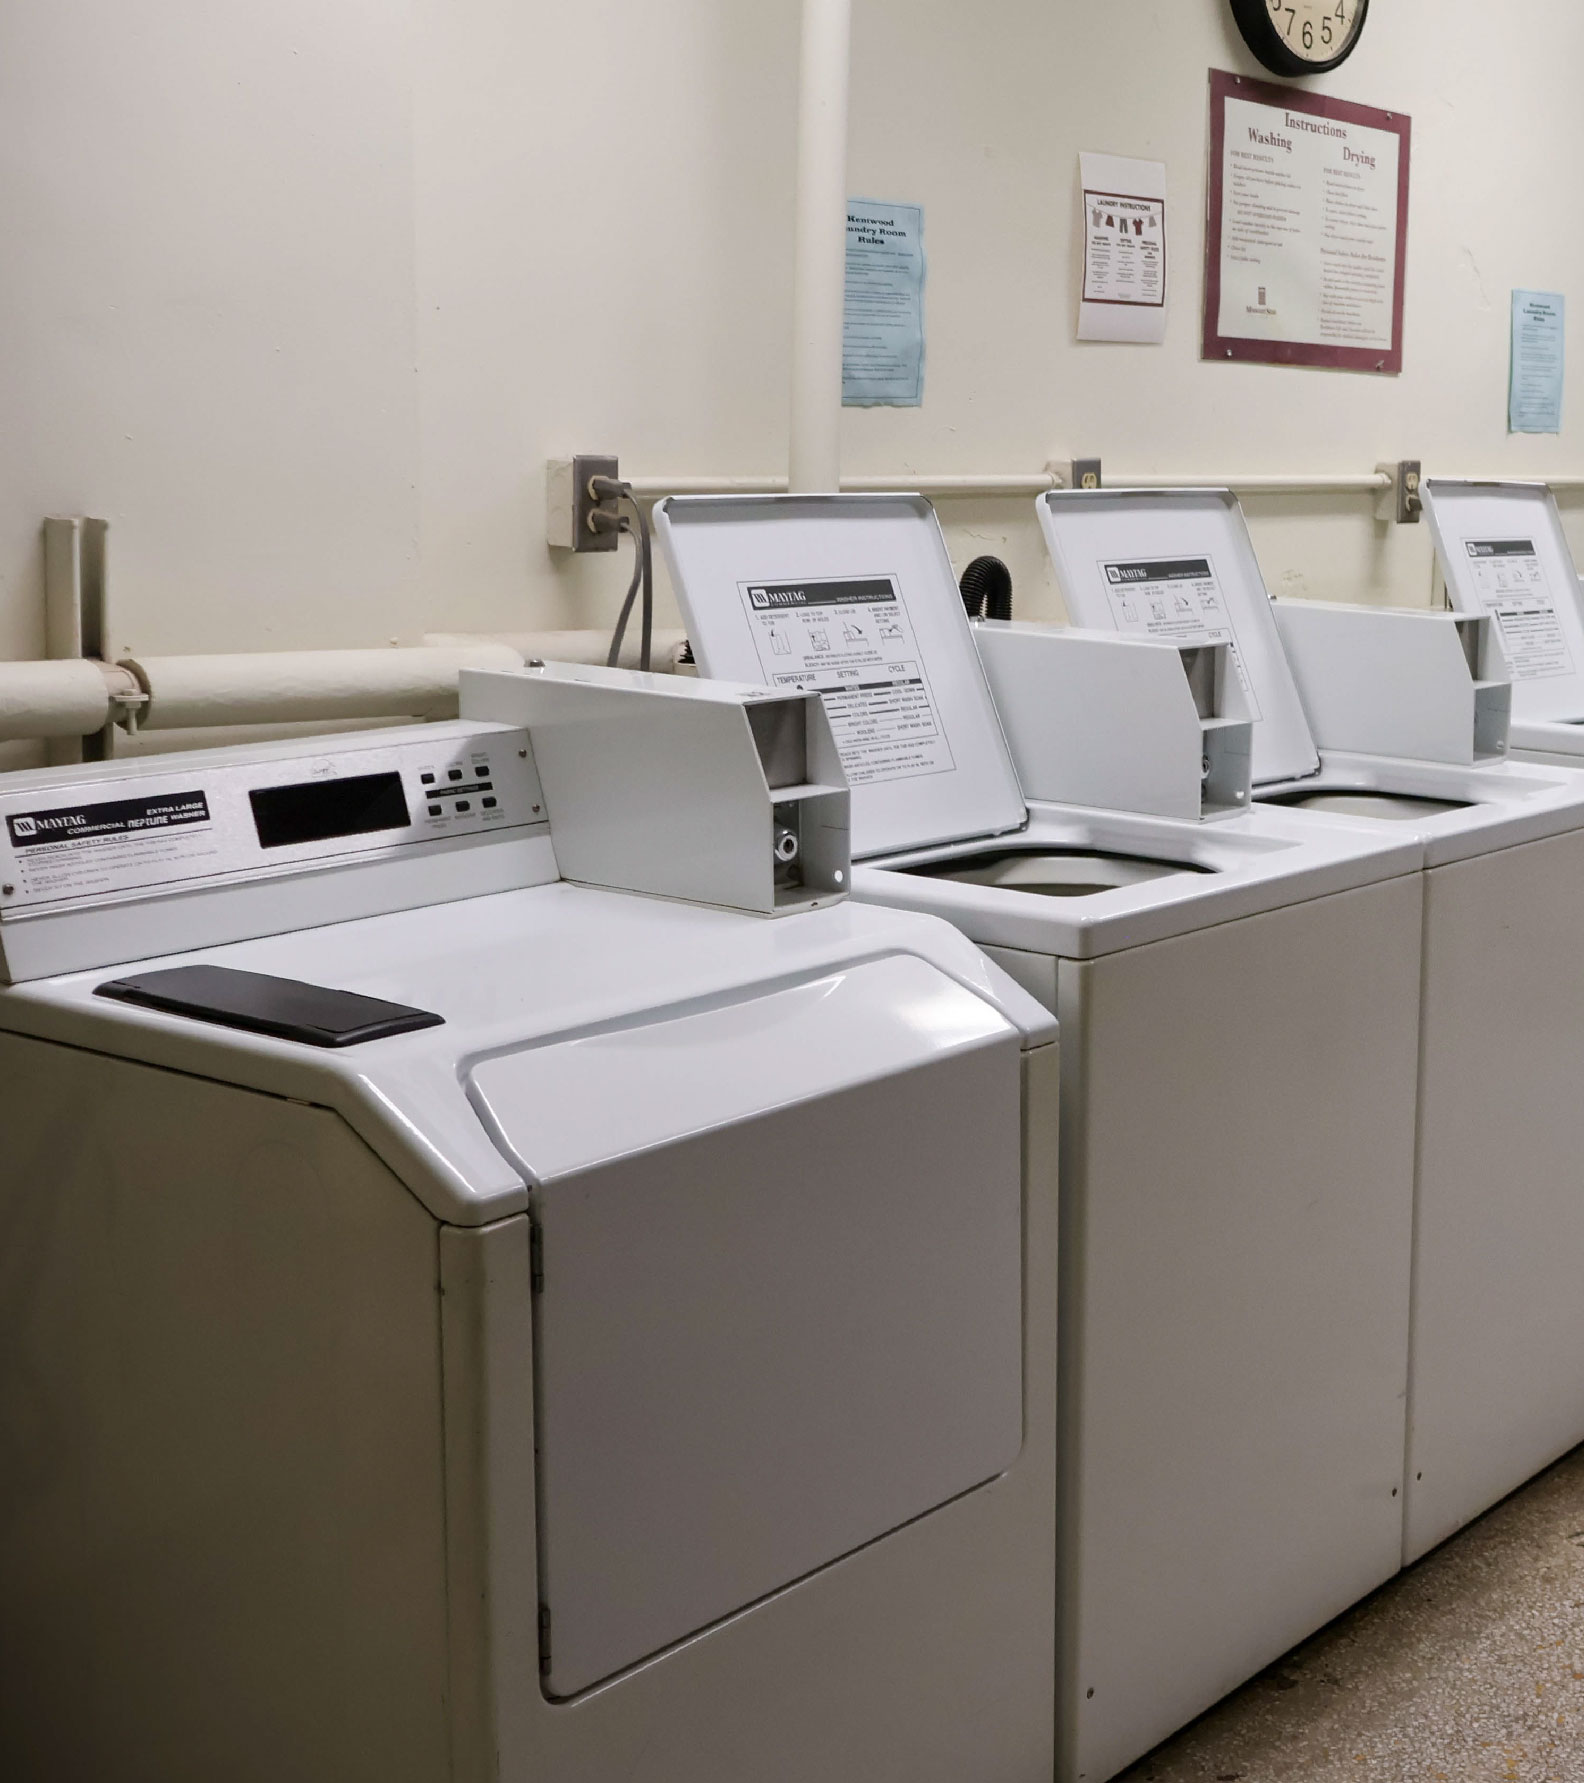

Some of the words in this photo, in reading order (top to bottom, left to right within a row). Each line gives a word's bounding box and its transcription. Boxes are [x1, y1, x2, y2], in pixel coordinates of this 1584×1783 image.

[1285, 8, 1295, 35] 7
[1335, 0, 1345, 25] 4
[1302, 21, 1313, 49] 6
[1321, 17, 1332, 44] 5
[1285, 112, 1348, 139] Instructions
[1248, 127, 1293, 153] Washing
[1343, 146, 1376, 170] Drying
[879, 228, 906, 237] Room
[768, 591, 806, 602] MAYTAG
[776, 673, 817, 685] TEMPERATURE
[837, 669, 860, 678] SETTING
[888, 664, 906, 673] CYCLE
[146, 805, 174, 816] EXTRA
[175, 802, 204, 812] LARGE
[36, 815, 87, 831] MAYTAG
[67, 822, 126, 835] COMMERCIAL
[170, 810, 206, 821] WASHER
[25, 843, 69, 854] PERSONAL
[71, 839, 102, 848] SAFETY
[103, 834, 129, 844] RULES
